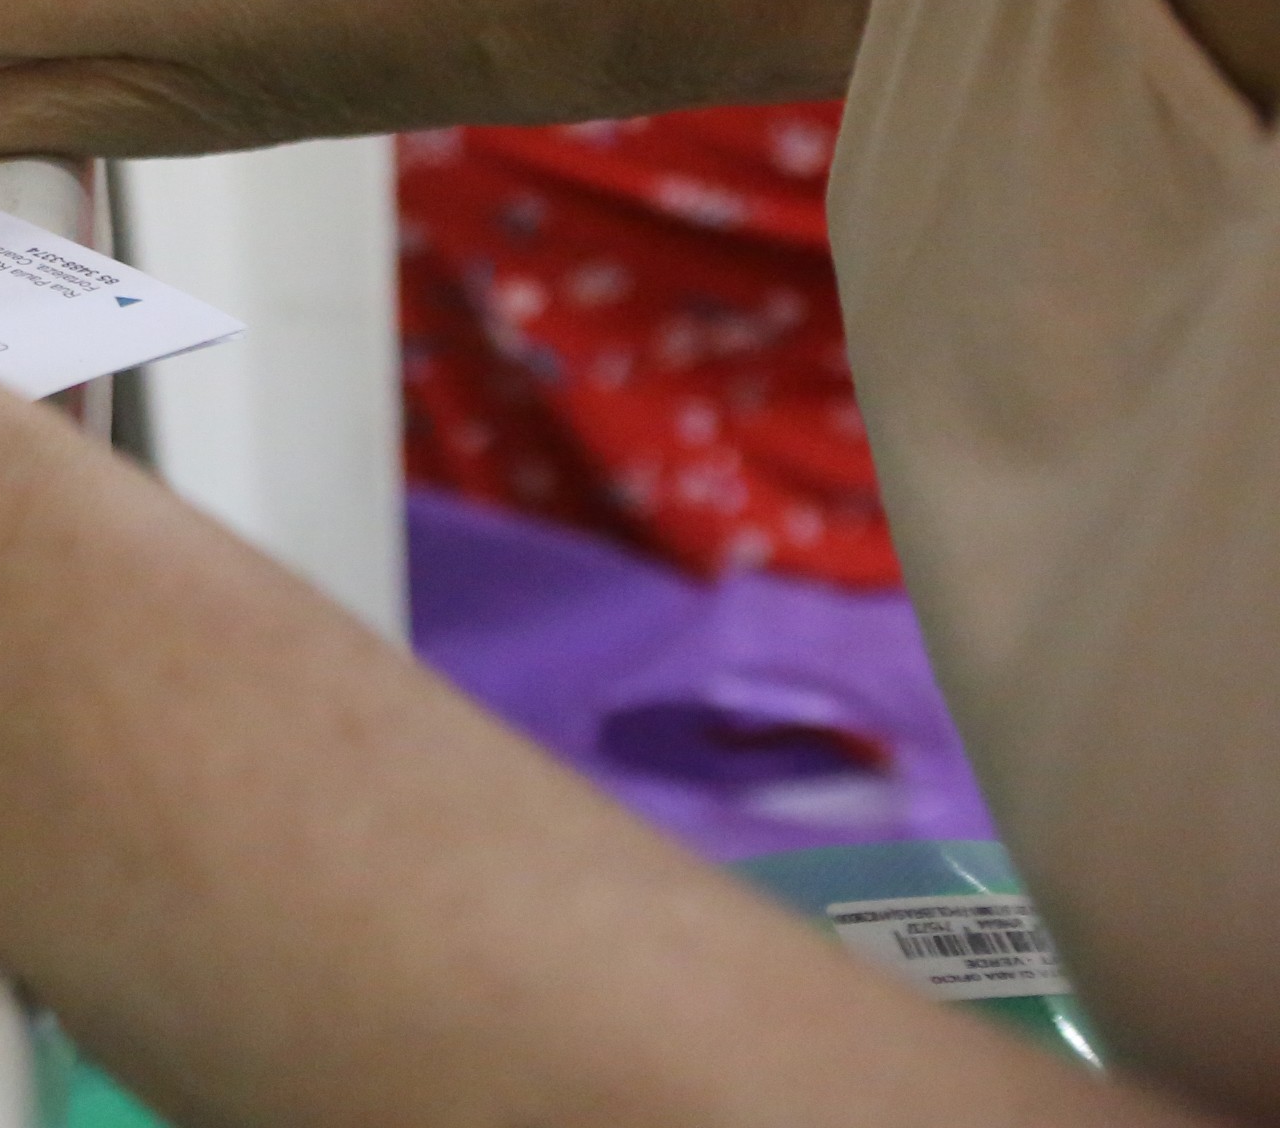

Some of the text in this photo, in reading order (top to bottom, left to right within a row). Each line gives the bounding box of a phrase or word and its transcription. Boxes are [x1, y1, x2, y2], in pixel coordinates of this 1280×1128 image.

[25, 248, 120, 285] 85 3488-3374
[10, 269, 52, 287] Paula
[50, 284, 81, 299] Rua
[964, 957, 1025, 969] VERDE
